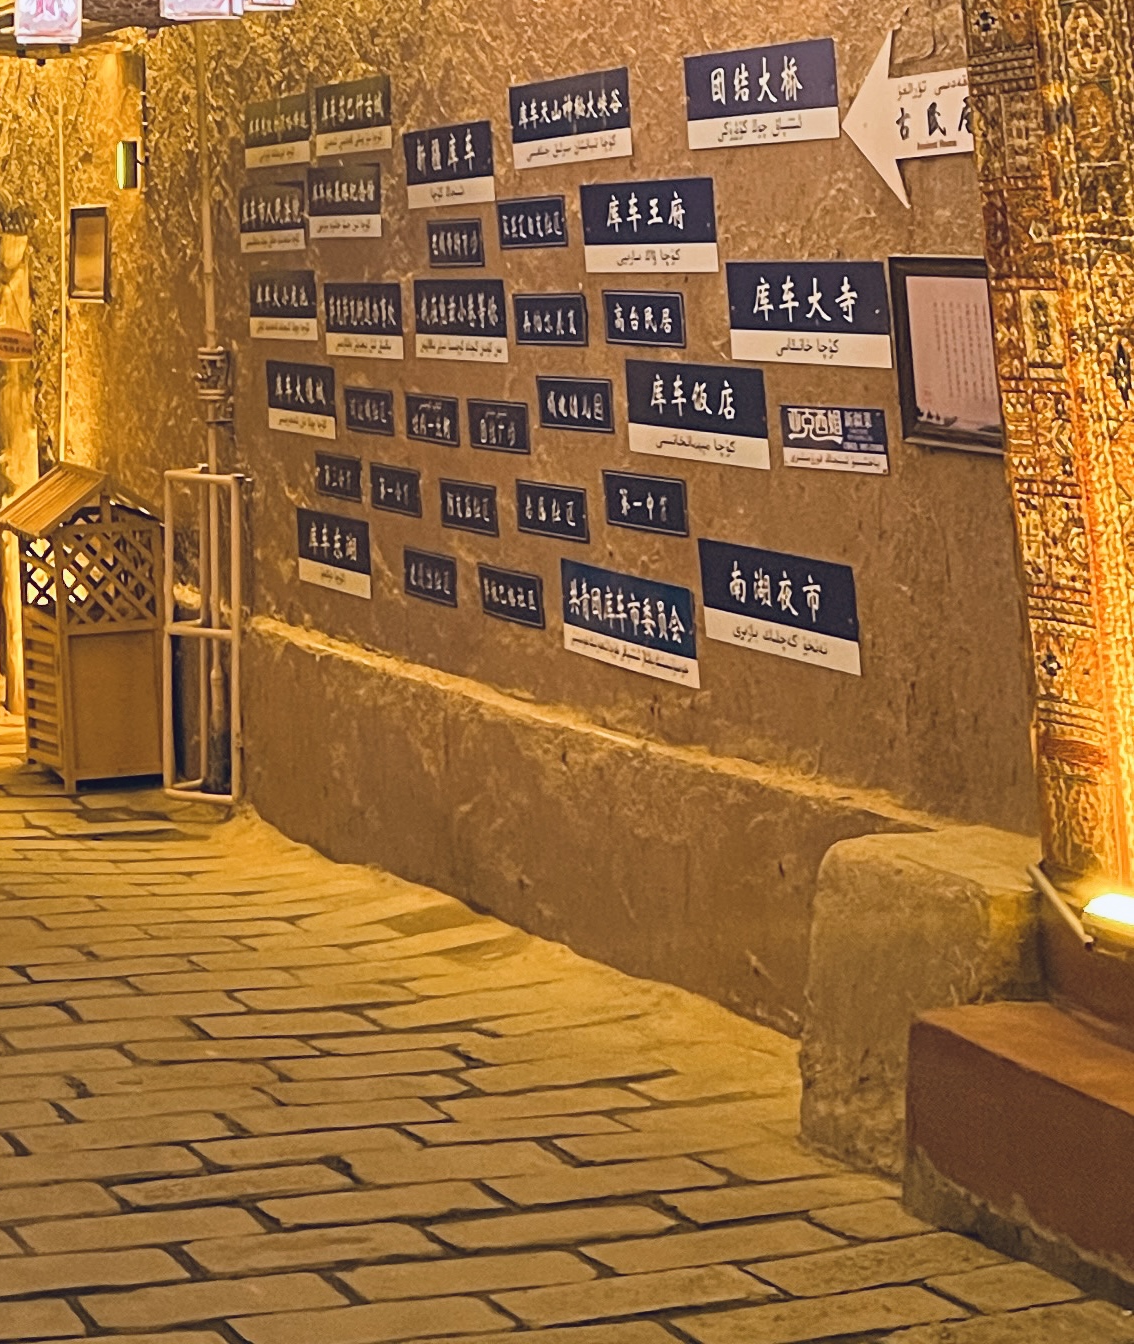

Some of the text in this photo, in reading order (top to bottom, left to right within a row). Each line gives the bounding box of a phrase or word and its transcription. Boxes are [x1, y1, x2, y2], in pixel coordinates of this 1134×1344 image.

[710, 55, 803, 105] 团结大桥
[518, 88, 623, 130] 库车天山神秘大峡谷
[606, 190, 686, 233] 库车王府
[613, 301, 673, 334] 高台民居
[753, 275, 859, 323] 库车大寺
[650, 373, 736, 420] 库车饭店
[568, 576, 686, 645] 共青团库车市委员会
[729, 560, 822, 624] 南湖夜市
